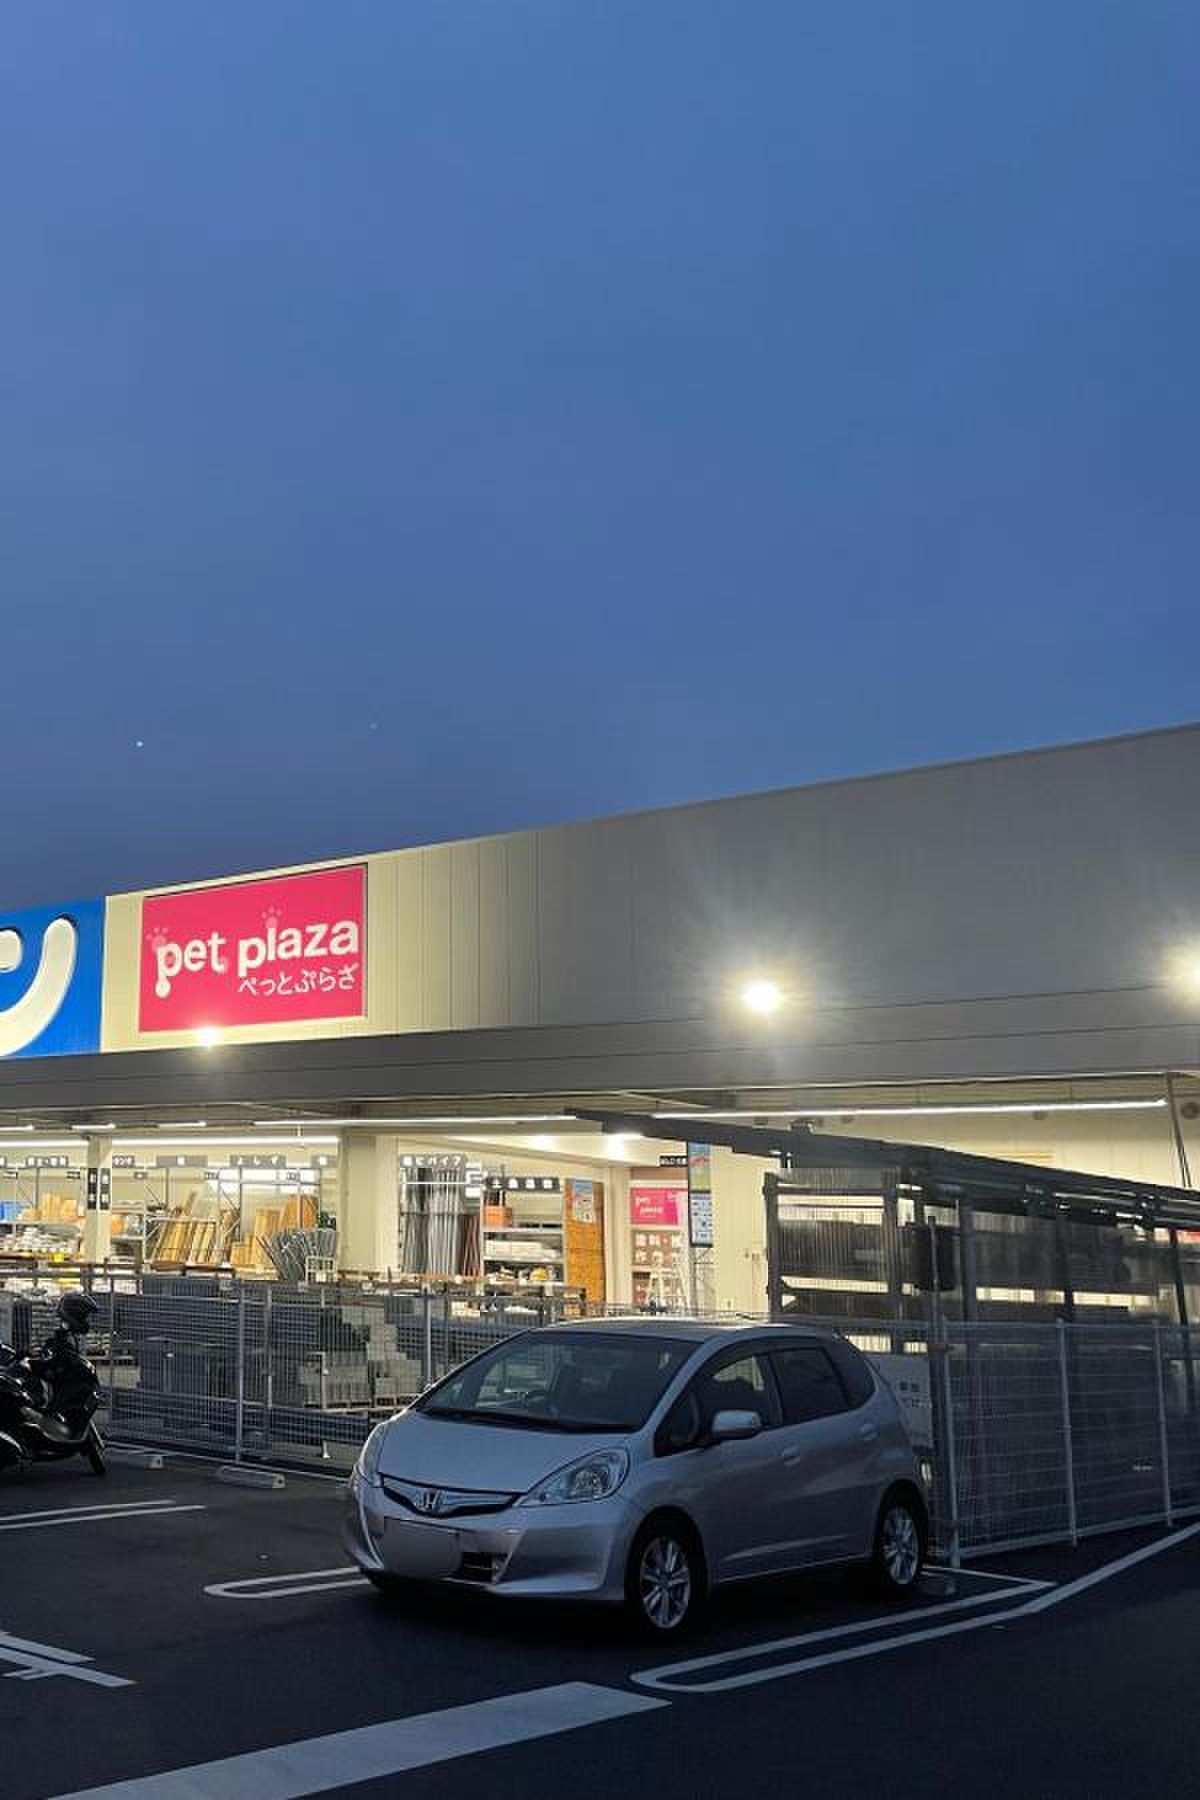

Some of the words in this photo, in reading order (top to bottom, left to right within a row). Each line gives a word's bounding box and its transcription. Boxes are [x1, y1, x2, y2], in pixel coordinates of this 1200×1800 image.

[155, 932, 226, 998] pet
[238, 920, 359, 977] plaza
[237, 963, 359, 996] ぺっとぷらざ
